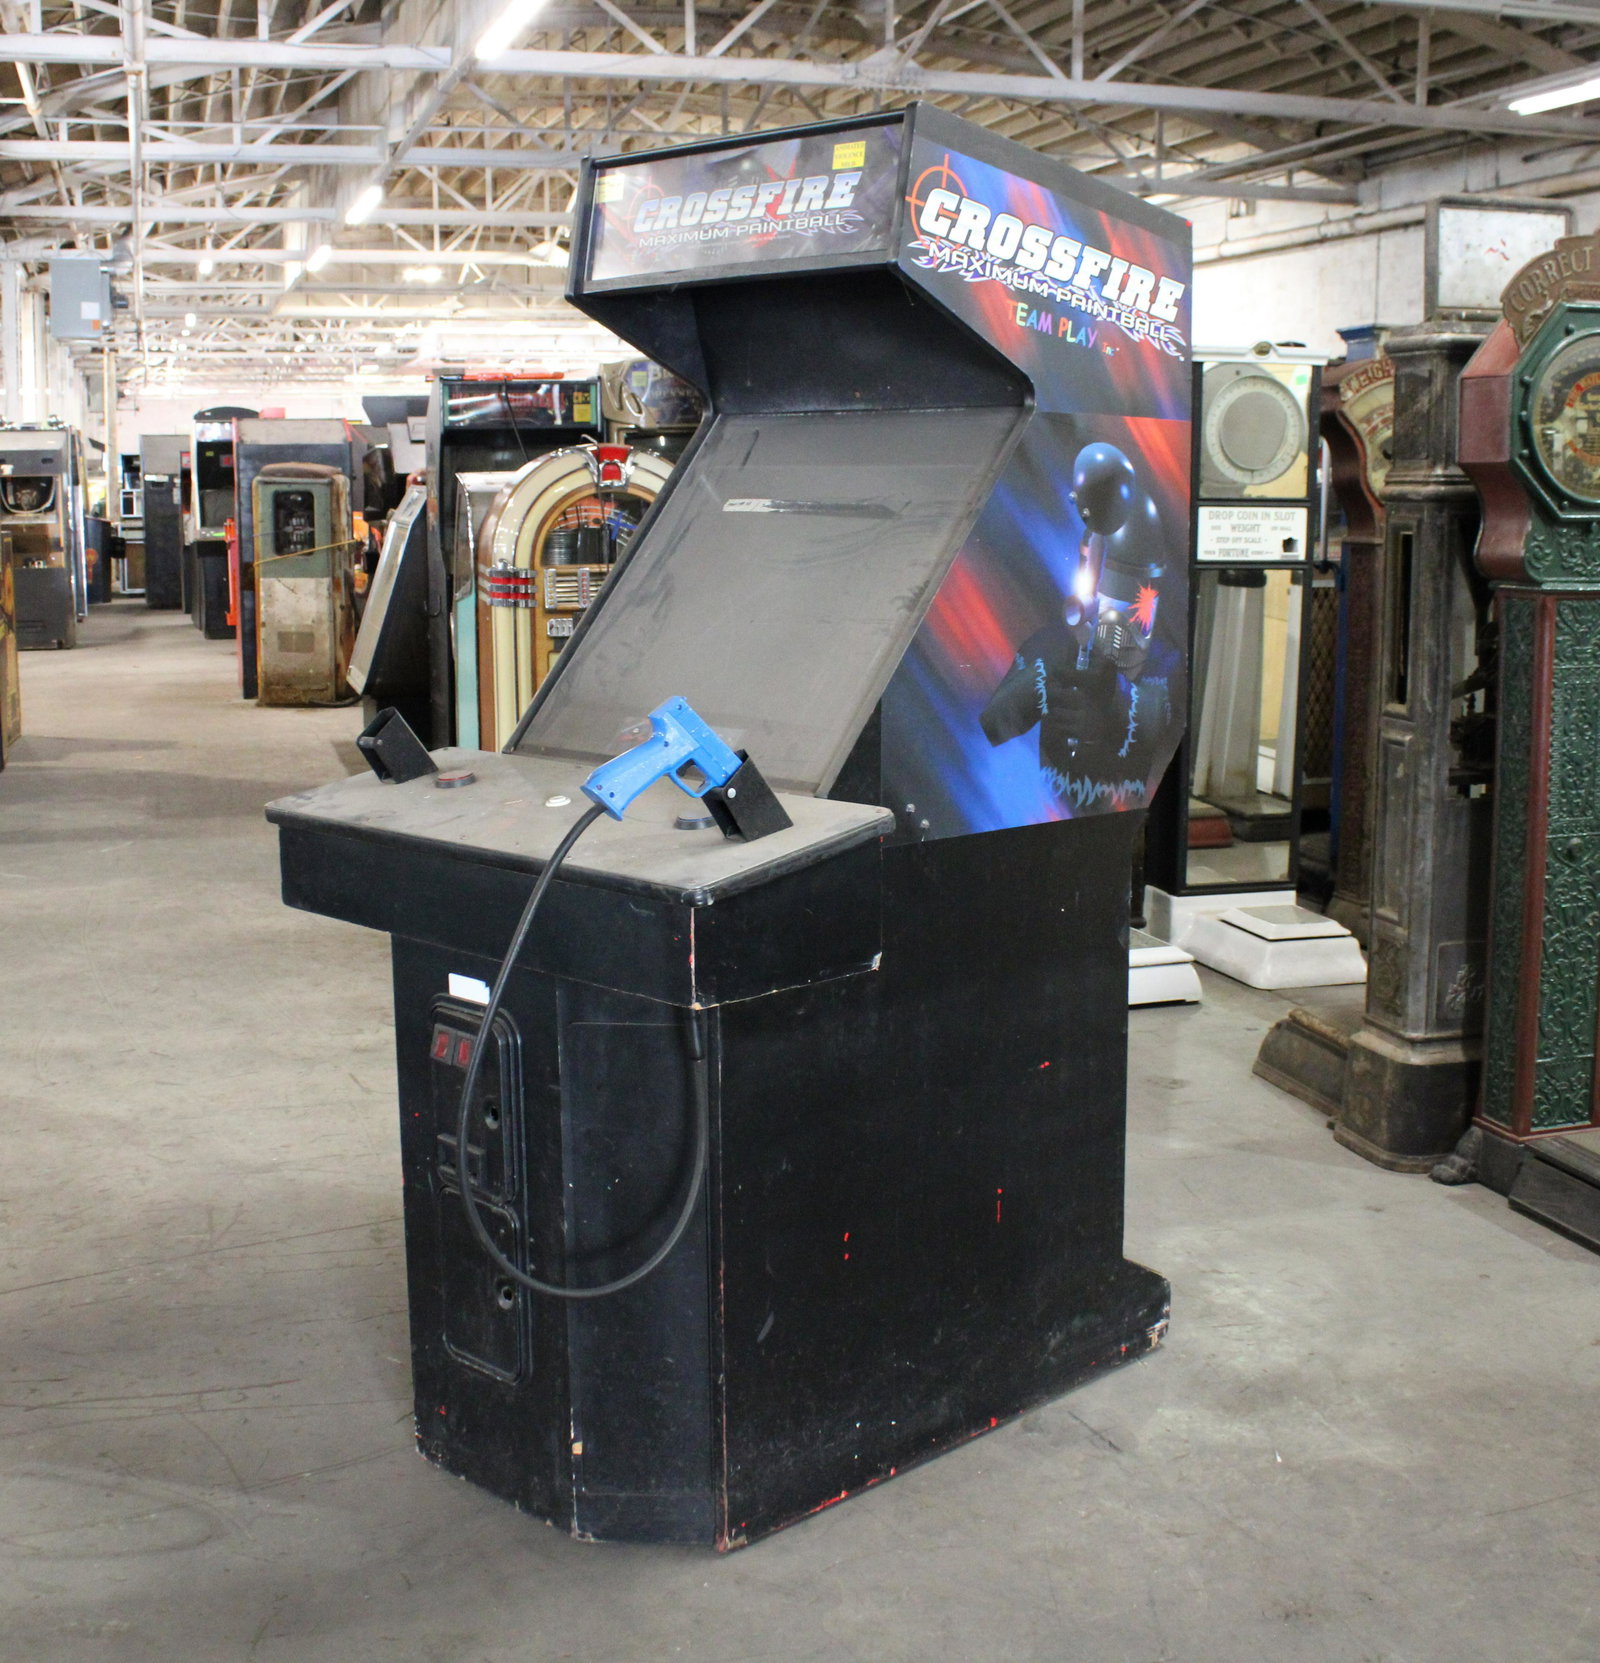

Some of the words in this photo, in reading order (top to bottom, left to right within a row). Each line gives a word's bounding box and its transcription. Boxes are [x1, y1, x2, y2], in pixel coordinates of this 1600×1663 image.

[633, 171, 862, 233] CROSSFIRE
[639, 227, 729, 248] MAXIMUM
[736, 214, 846, 237] PAINTBALL
[919, 187, 1186, 323] CROSSFIRE
[928, 242, 1049, 299] MAXIMUM
[1055, 287, 1170, 342] PAINTBALL
[1509, 246, 1594, 312] CORRECT
[1007, 301, 1053, 336] TEAM
[1058, 316, 1098, 349] PLAY
[1208, 510, 1233, 521] DROP
[1236, 510, 1259, 521] COIN
[1261, 511, 1271, 521] IN
[1273, 511, 1296, 521] SLOT
[1230, 523, 1261, 533] WEIGHT
[1218, 548, 1250, 558] FORTUNE
